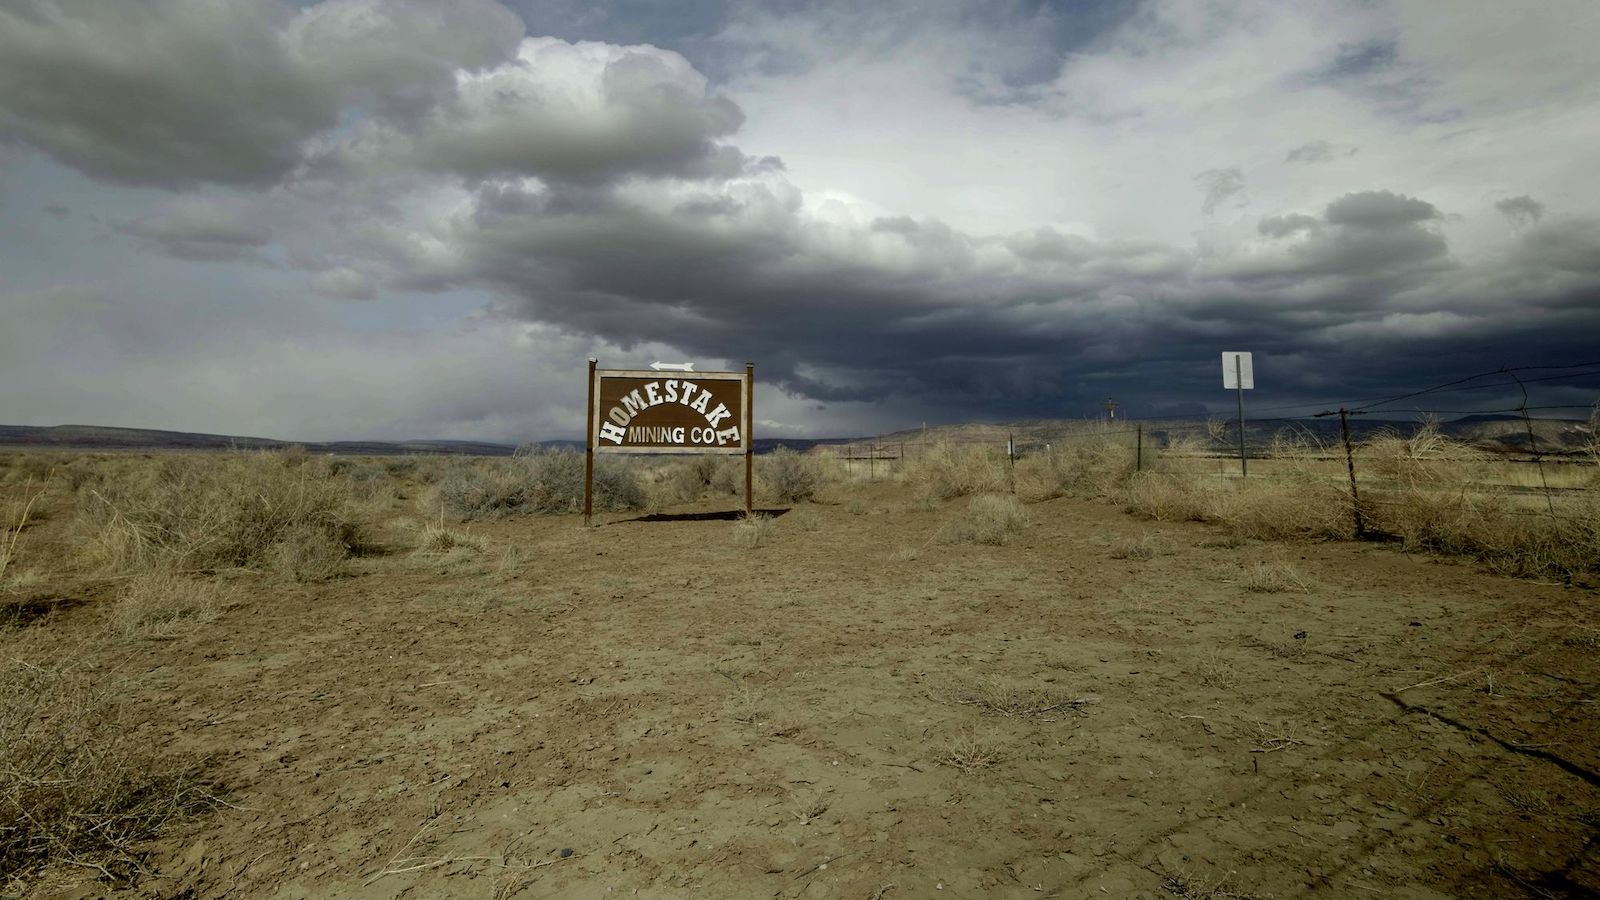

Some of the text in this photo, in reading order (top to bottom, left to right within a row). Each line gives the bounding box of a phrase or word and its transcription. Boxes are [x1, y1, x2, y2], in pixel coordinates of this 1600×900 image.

[600, 380, 740, 445] HOMESTAKE
[628, 426, 715, 444] MINING CO
